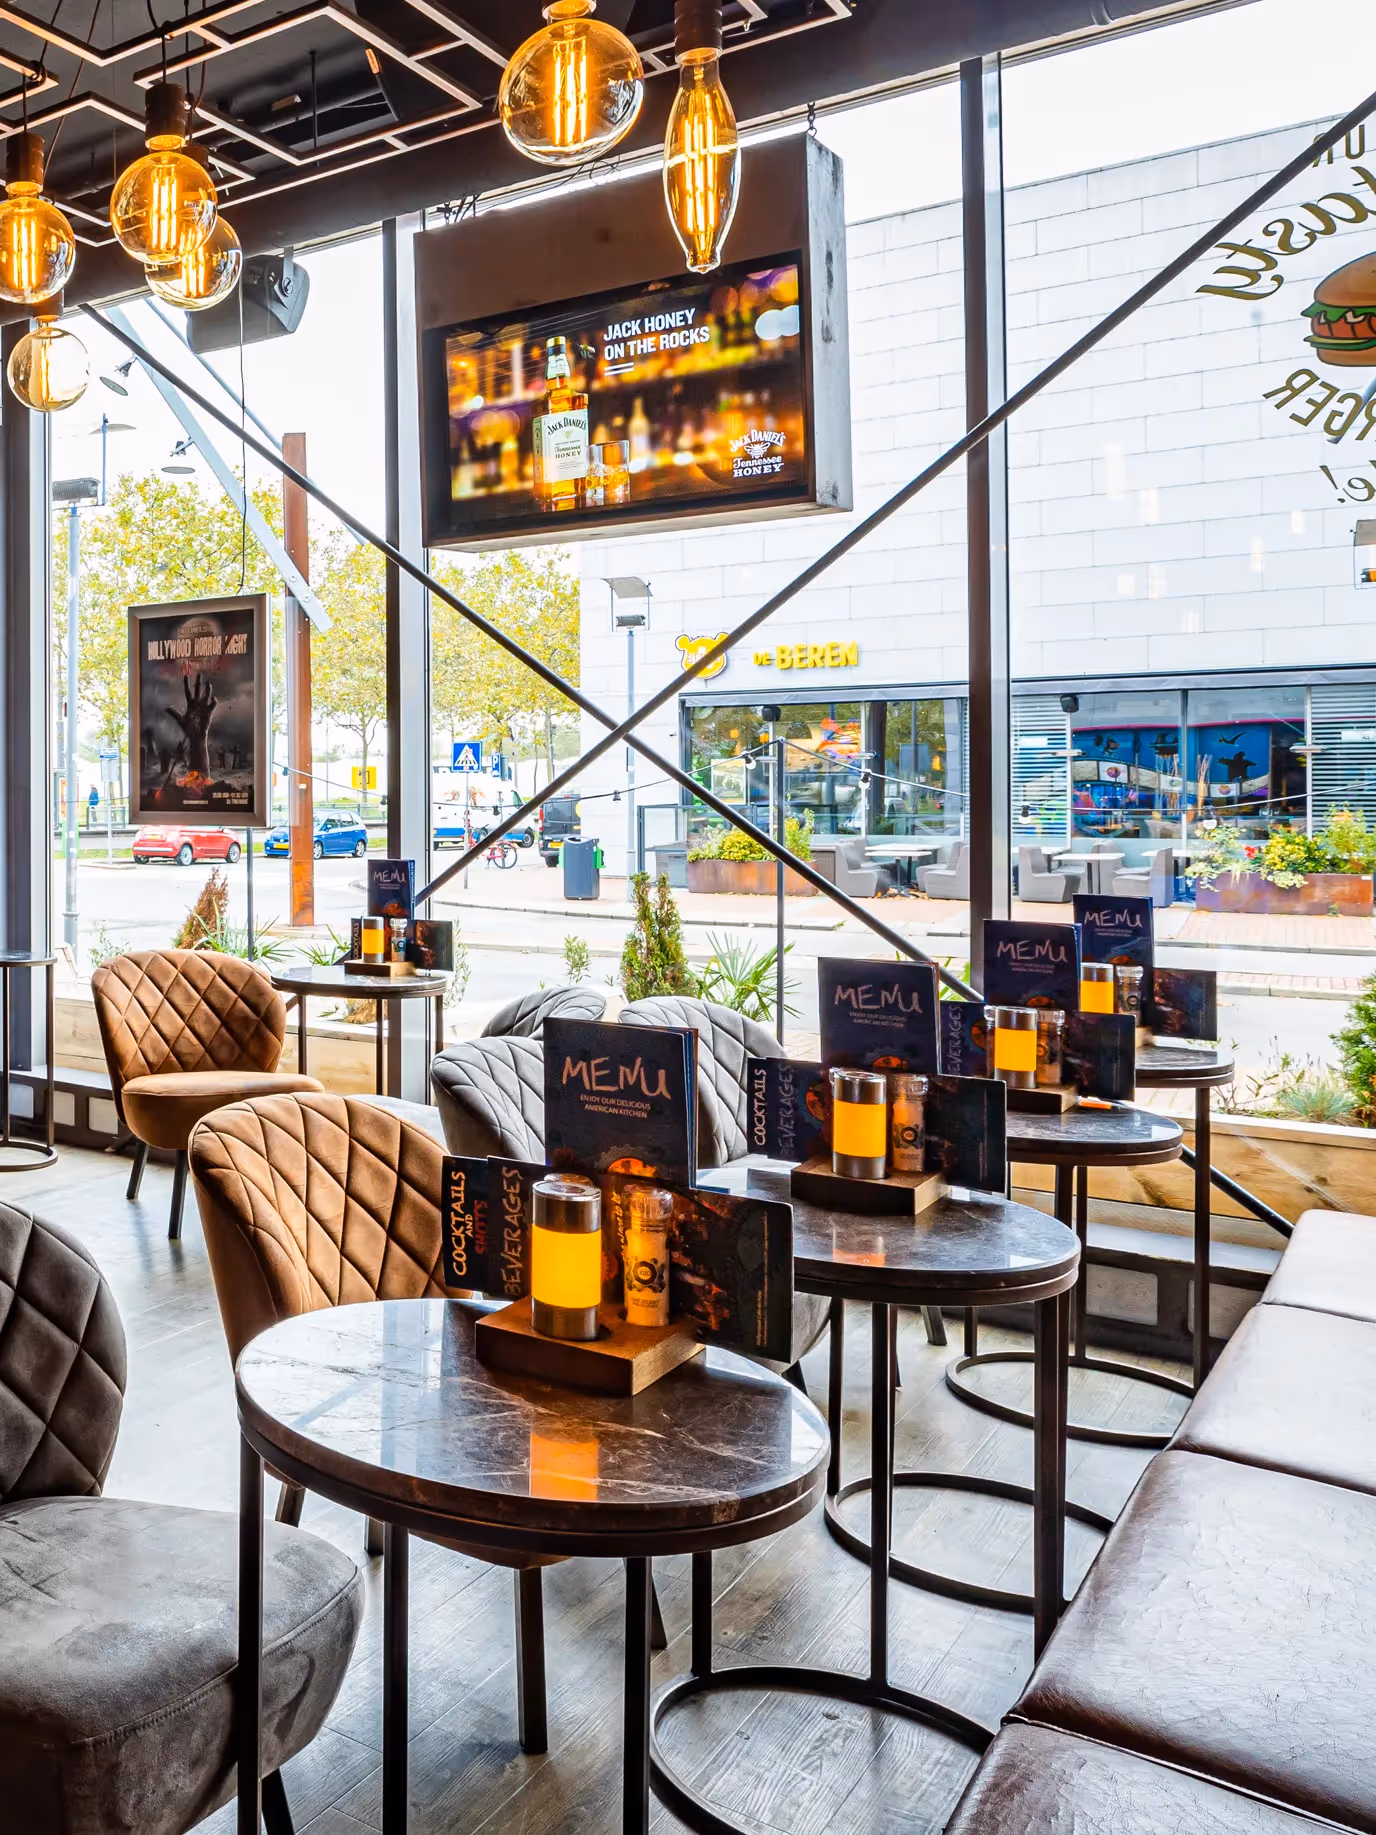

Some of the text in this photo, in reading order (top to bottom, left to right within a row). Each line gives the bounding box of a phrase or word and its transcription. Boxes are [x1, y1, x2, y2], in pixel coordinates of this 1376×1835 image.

[604, 308, 696, 342] JACK HONEY
[604, 326, 711, 361] ON THE ROCKS
[547, 421, 564, 436] JACK
[729, 429, 787, 453] JACK DANIEL'S
[555, 450, 581, 459] HONEY
[733, 455, 783, 469] Tennessee
[732, 462, 785, 478] HONEY
[147, 638, 192, 661] HOLLYWOOD
[194, 635, 222, 657] HORROR
[775, 641, 859, 670] BEREN
[373, 869, 407, 883] MENU
[1084, 909, 1144, 928] MENU
[996, 939, 1069, 963] MENU
[833, 983, 923, 1013] MENU
[561, 1056, 672, 1100] MENU
[580, 1094, 651, 1110] ENJOY OUR DELICIOUS
[584, 1103, 648, 1118] AMERICAN KITCHEN
[753, 1068, 767, 1146] COCKTAILS
[777, 1063, 796, 1156] BEVERAGES
[450, 1171, 468, 1276] COCKTAILS
[465, 1213, 474, 1238] AND
[474, 1199, 489, 1255] SHOTS
[501, 1165, 524, 1296] BEVERAGES
